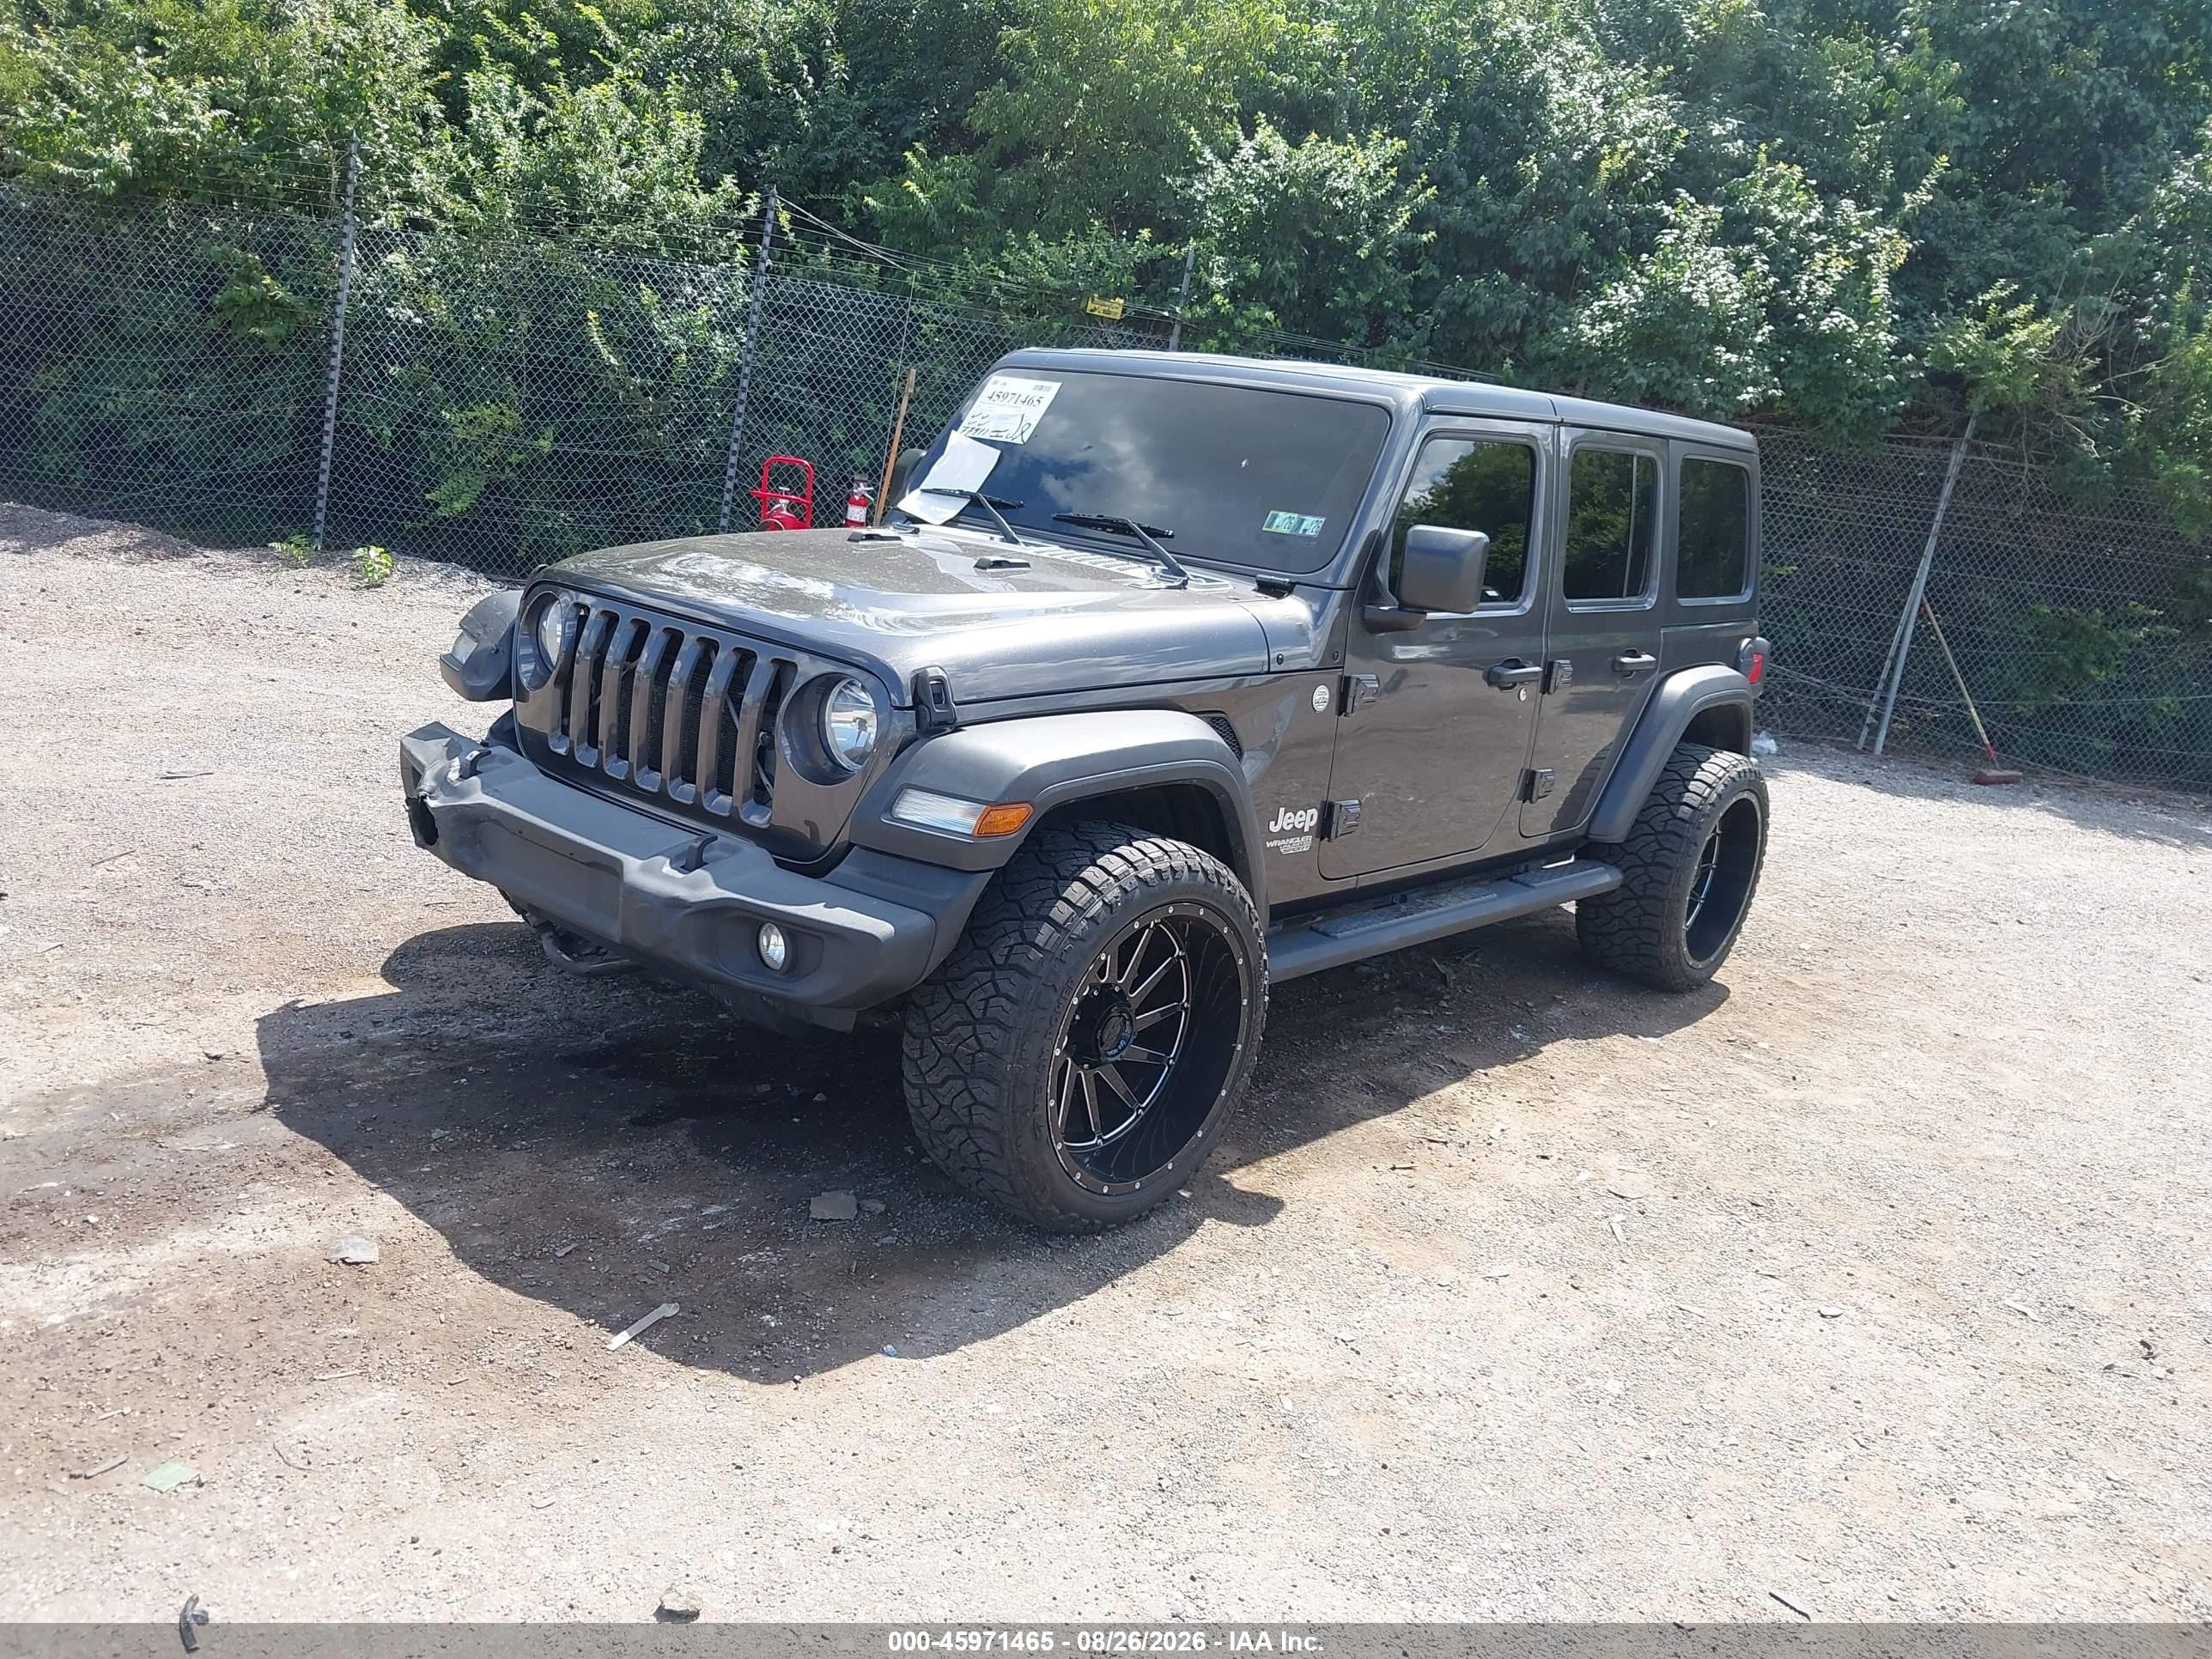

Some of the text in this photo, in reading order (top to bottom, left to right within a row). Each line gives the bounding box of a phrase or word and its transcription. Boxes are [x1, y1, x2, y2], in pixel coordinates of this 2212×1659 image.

[988, 390, 1044, 407] 45971465
[1268, 807, 1318, 833] Jeep
[1266, 835, 1313, 848] WRANGLER
